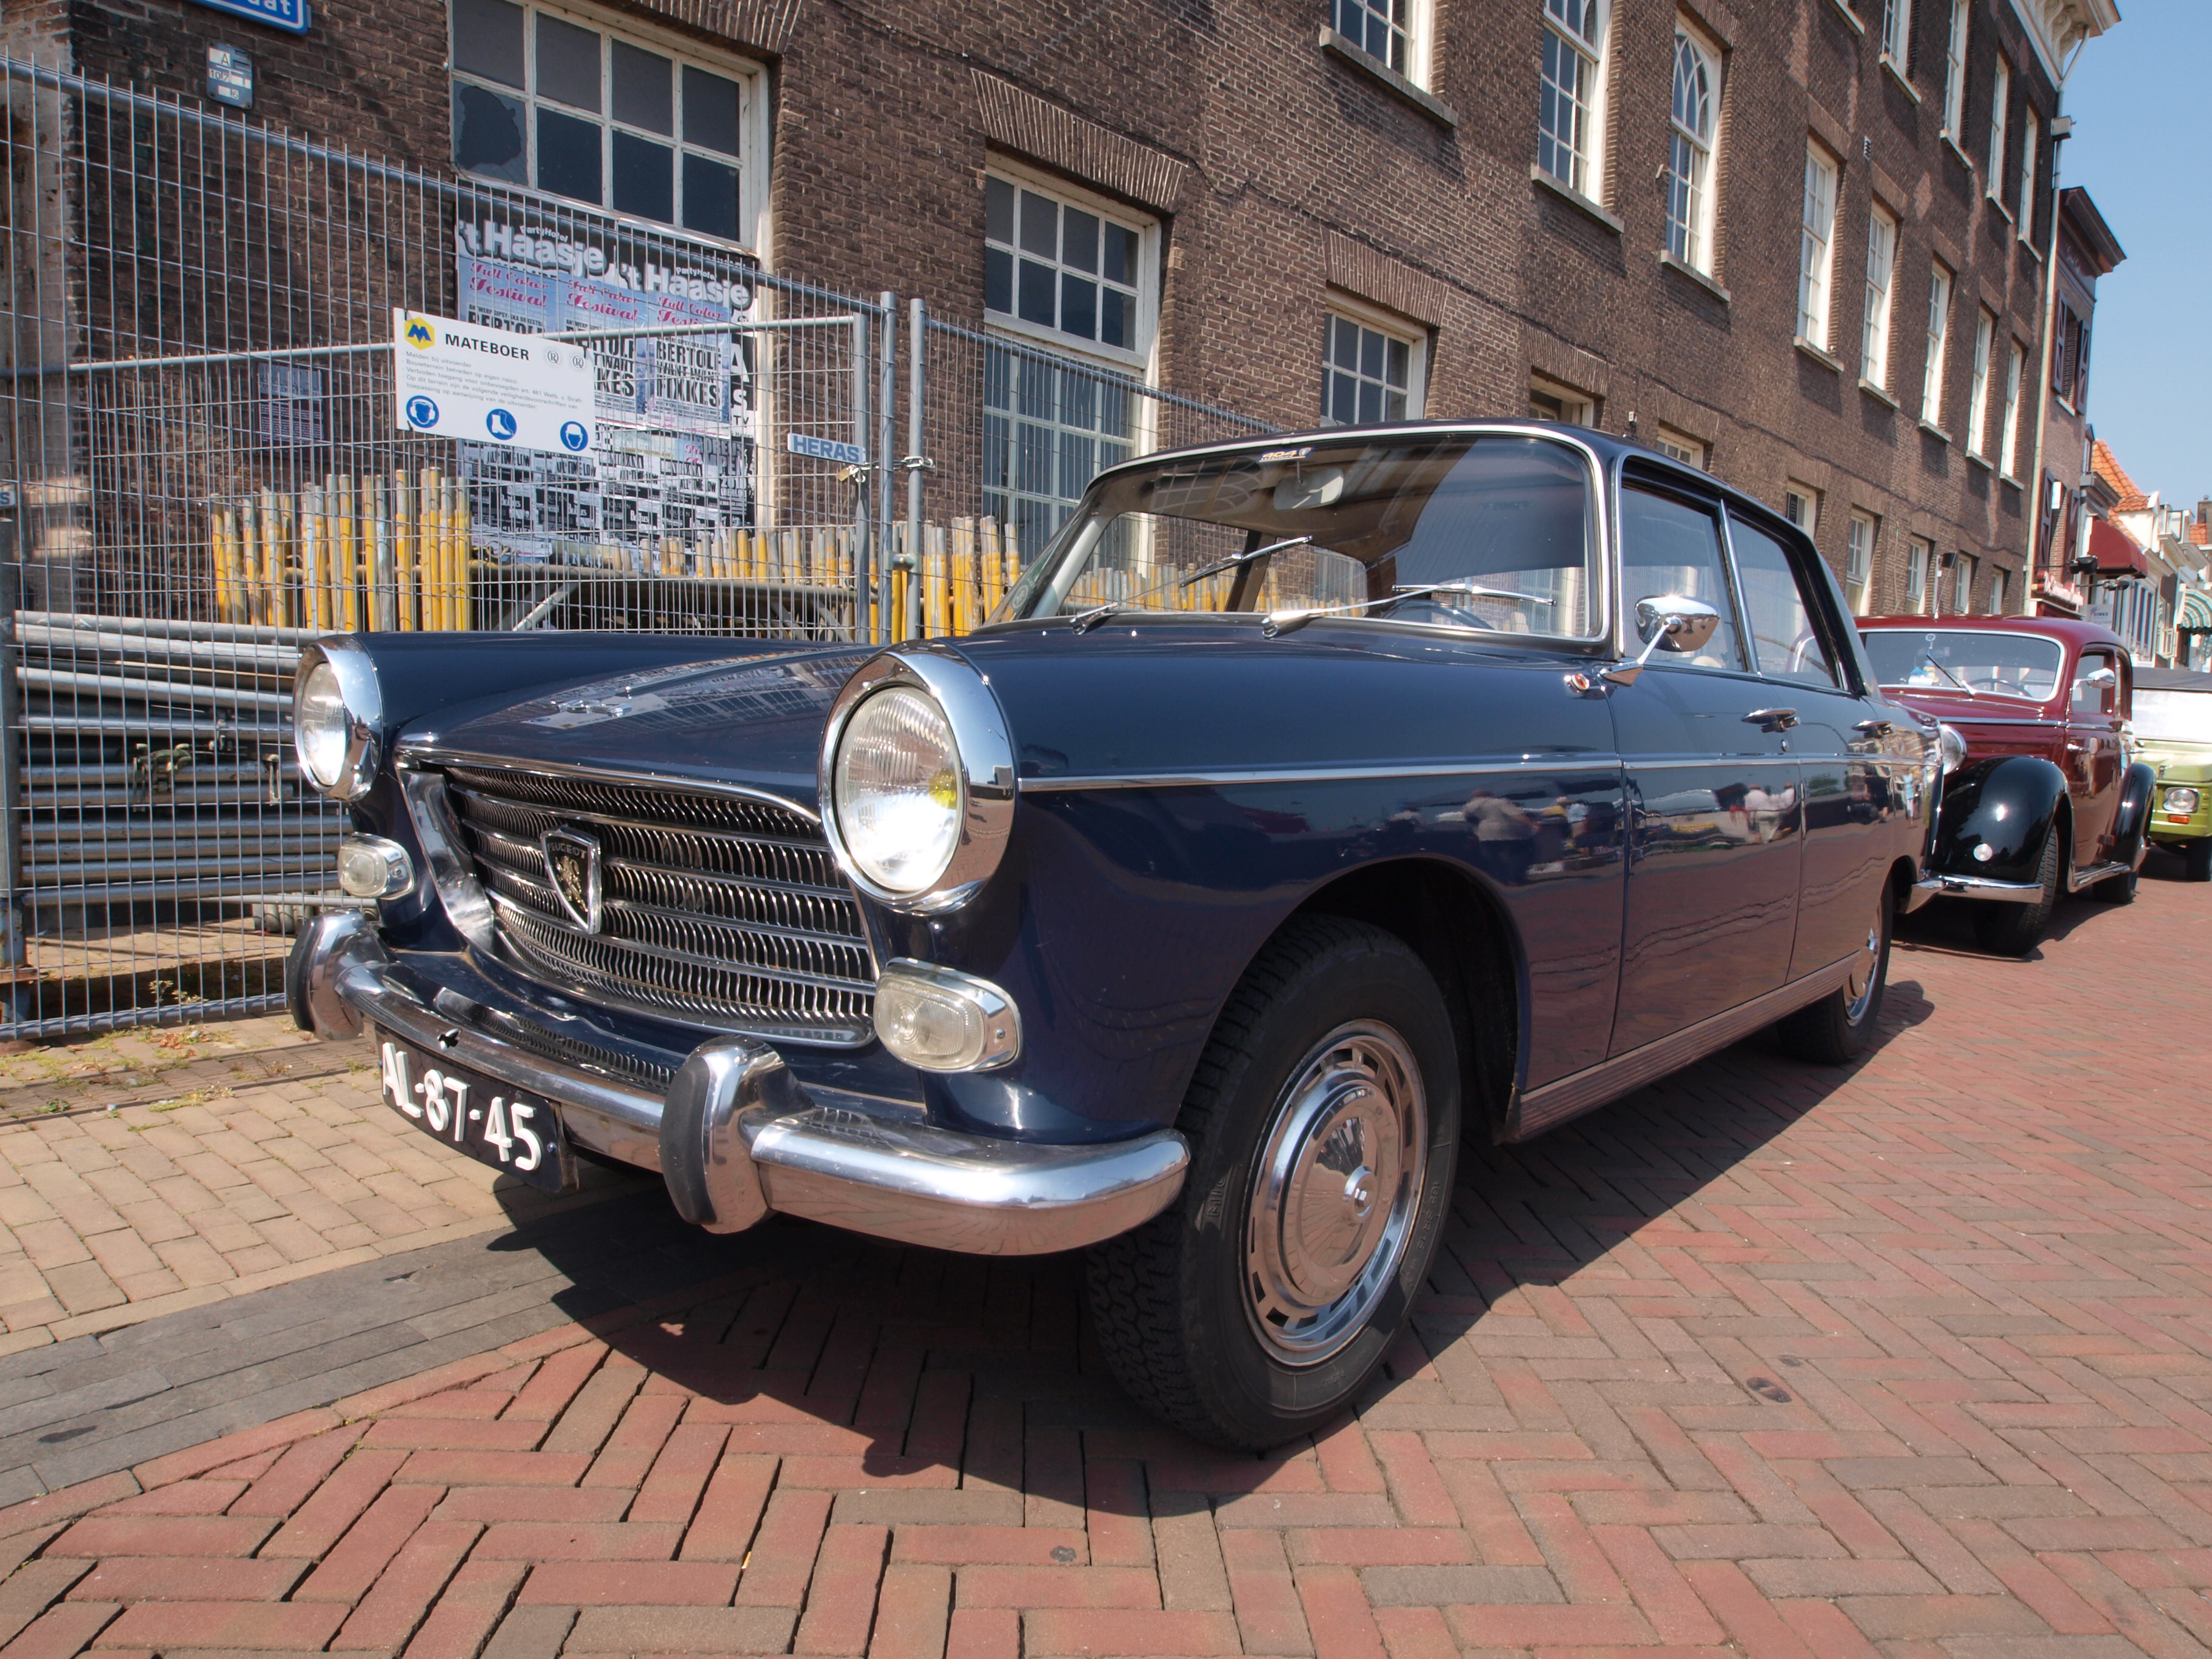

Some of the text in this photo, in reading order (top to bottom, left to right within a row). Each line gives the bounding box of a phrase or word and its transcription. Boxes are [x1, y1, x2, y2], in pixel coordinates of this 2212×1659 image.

[221, 53, 229, 66] A
[484, 220, 603, 277] Haasje
[471, 263, 548, 290] Full Color
[645, 263, 749, 307] Haasje
[470, 277, 547, 307] Festival
[567, 293, 638, 321] Festival
[406, 351, 429, 360] Melden
[441, 358, 472, 367] uitvoerder
[444, 333, 529, 361] MATEBOER
[657, 341, 722, 370] BERTOLF
[406, 359, 444, 370] Bouwterrein
[446, 367, 472, 376] betreden
[406, 367, 436, 377] Verboden
[438, 374, 463, 383] toegang
[480, 380, 520, 392] onbevoegden
[406, 383, 440, 394] toepassing
[452, 391, 483, 401] aanwijzing
[472, 386, 498, 396] volgende
[794, 435, 859, 463] HERAS
[547, 842, 588, 859] PEUGEOT
[382, 1041, 542, 1171] AL-87-45
